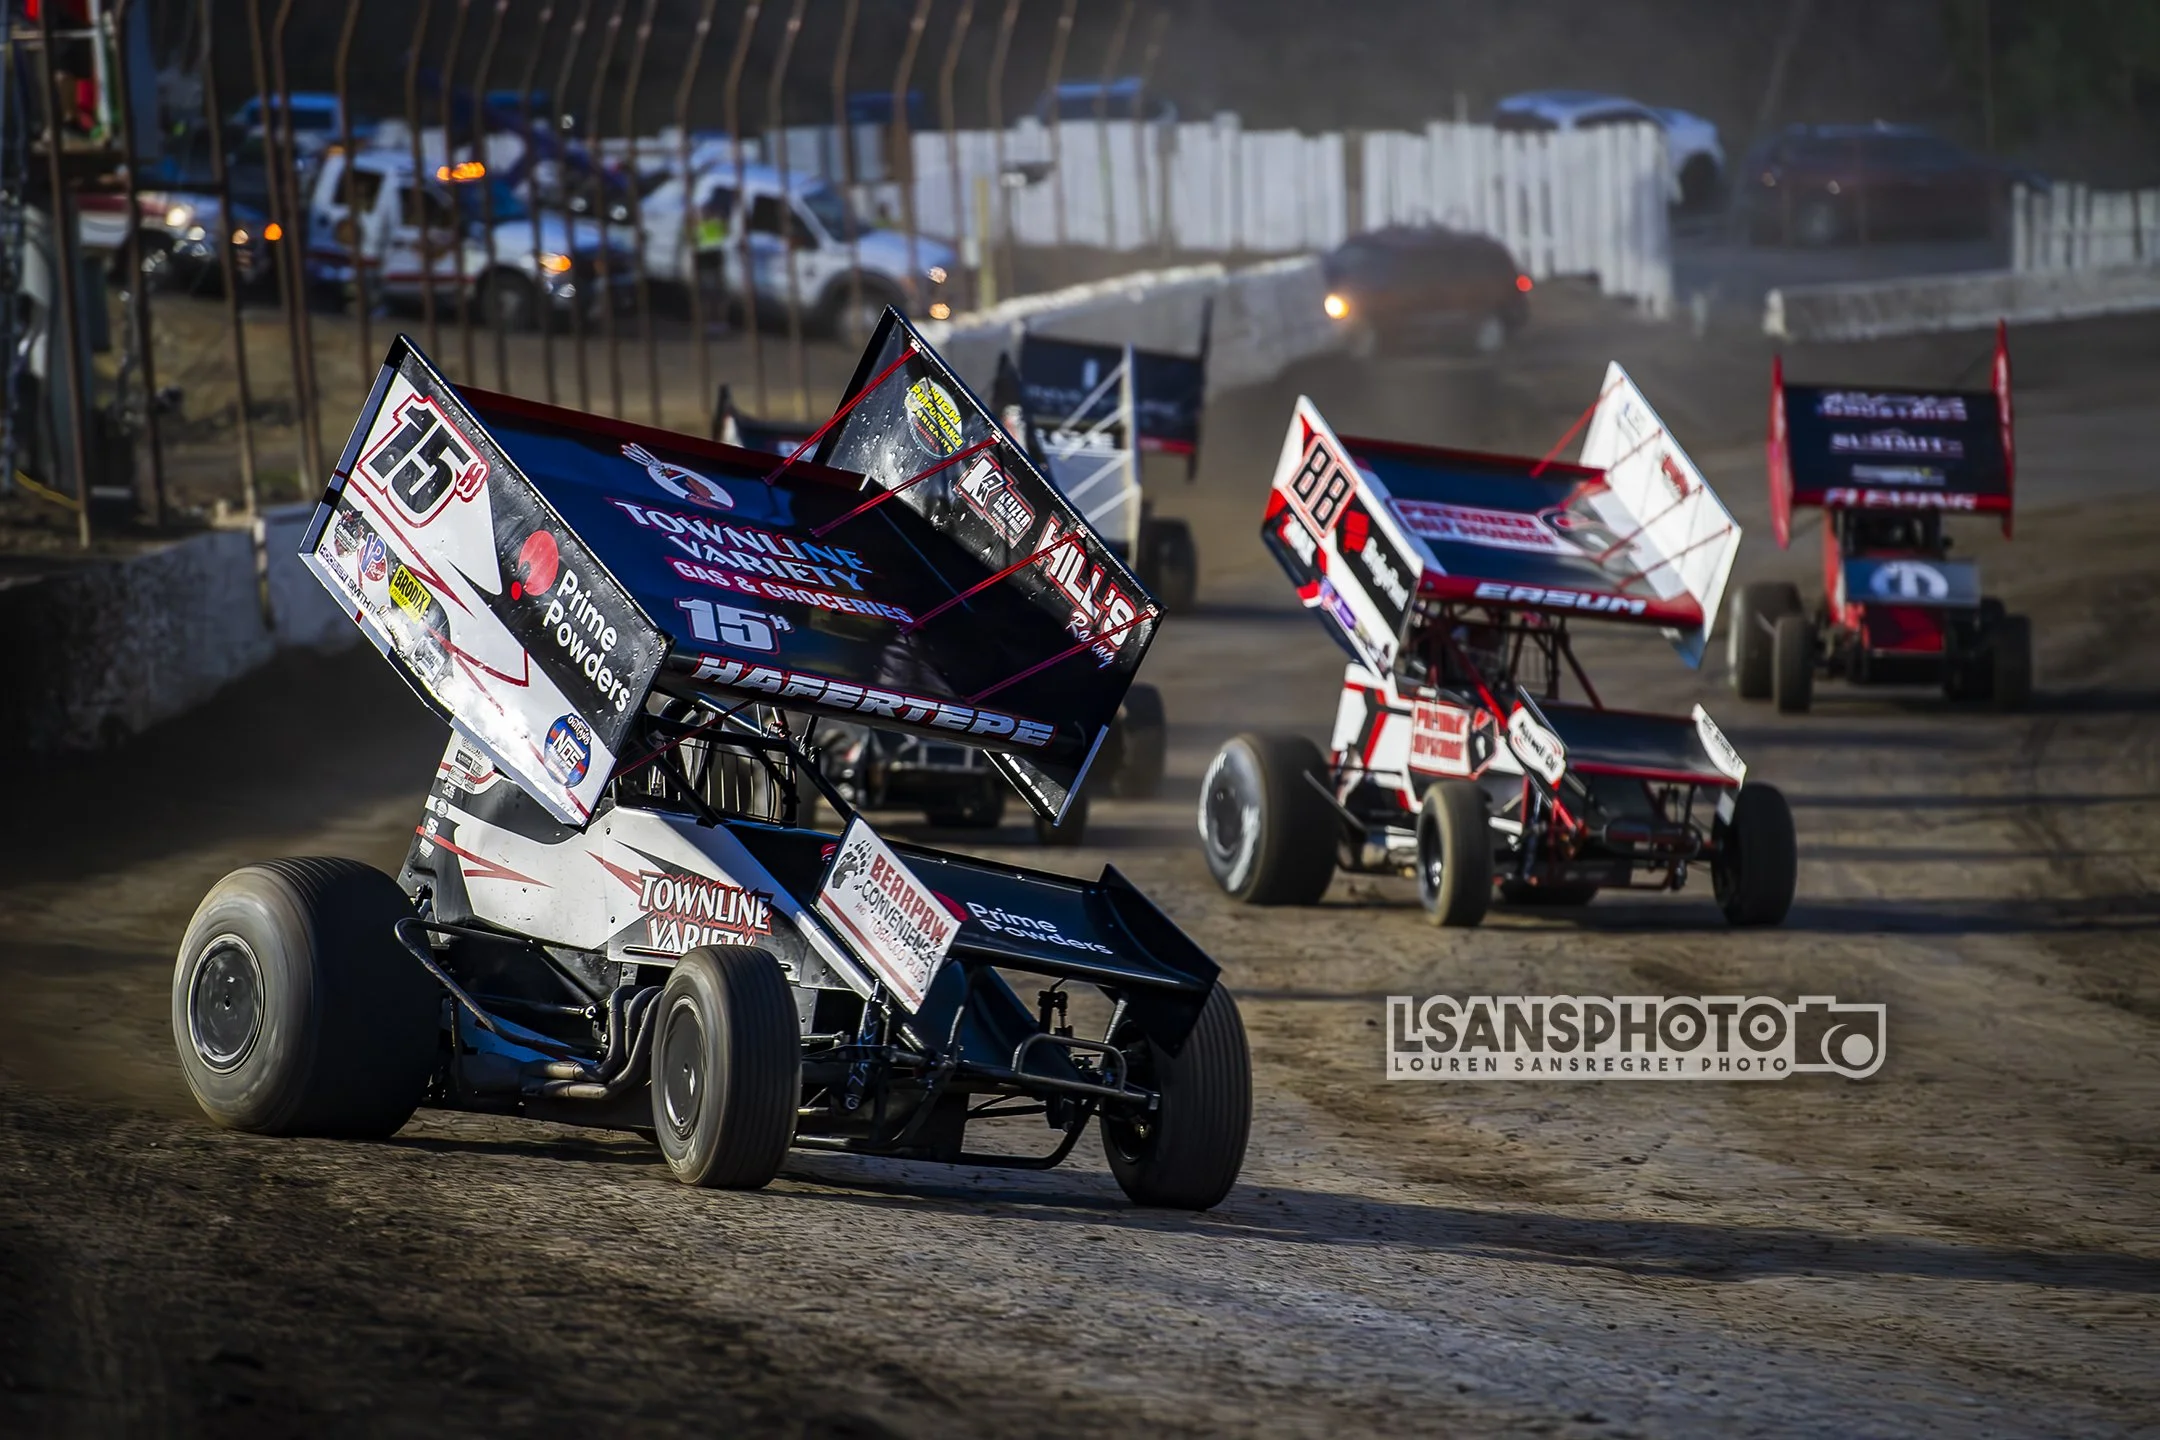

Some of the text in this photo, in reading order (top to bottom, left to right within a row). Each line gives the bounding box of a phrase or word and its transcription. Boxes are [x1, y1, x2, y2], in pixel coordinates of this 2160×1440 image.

[998, 490, 1032, 528] KEIZER
[1292, 442, 1351, 531] 88
[614, 501, 873, 574] TOWNLINE
[668, 535, 864, 591] VARIETY
[393, 569, 428, 613] BRODIX
[556, 569, 618, 652] Prime
[673, 560, 915, 623] GAS & GROCERIES
[1037, 522, 1135, 646] HILL'S
[1474, 581, 1647, 616] EASUM
[542, 599, 631, 712] Powders
[1065, 611, 1115, 668] Raing
[690, 656, 1055, 748] HAFERTEPE
[552, 728, 587, 771] NOS
[641, 875, 769, 930] TOWNLINE
[861, 879, 936, 968] CONVENIENCE
[869, 853, 950, 945] BEARPAW
[966, 901, 1058, 933] Prime
[980, 919, 1114, 955] Powders
